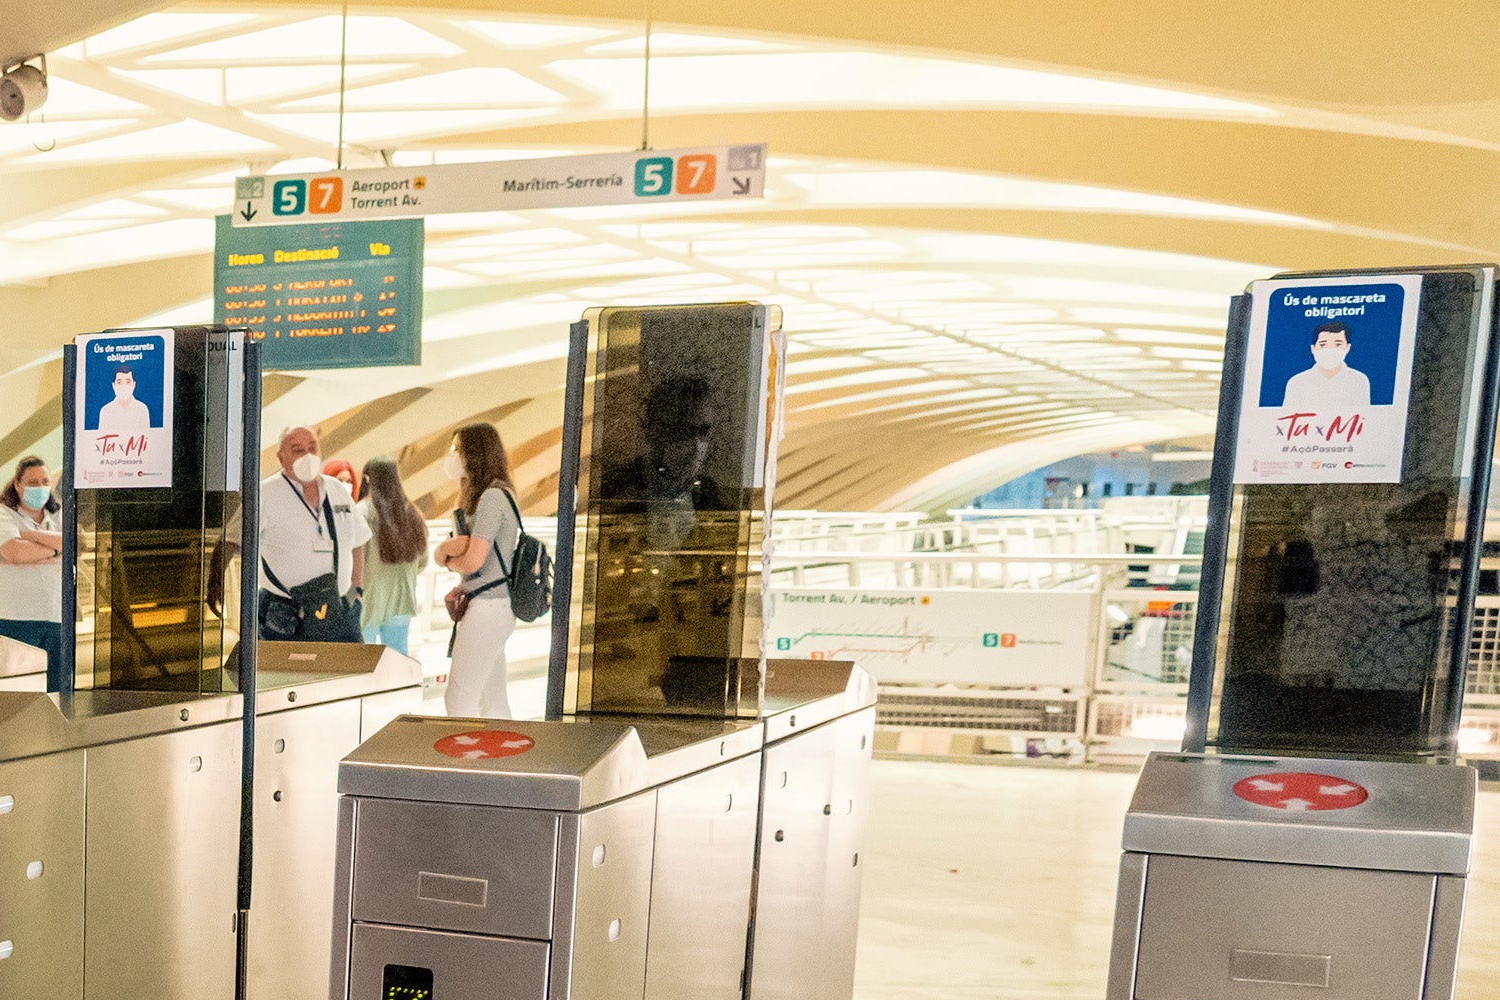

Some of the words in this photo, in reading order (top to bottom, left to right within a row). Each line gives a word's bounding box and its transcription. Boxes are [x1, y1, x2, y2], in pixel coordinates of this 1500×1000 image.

[643, 164, 663, 192] 5
[688, 161, 706, 188] 7
[280, 186, 298, 212] 5
[318, 183, 334, 209] 7
[352, 179, 409, 194] Aeroport
[351, 196, 398, 209] Torrent
[402, 194, 421, 206] Av.
[1283, 293, 1300, 306] Ús
[1302, 295, 1318, 305] de
[1320, 293, 1386, 304] mascareta
[1304, 305, 1365, 319] obligatori
[93, 343, 104, 353] Ús
[116, 343, 154, 351] mascareta
[107, 352, 142, 363] obligatori
[782, 592, 826, 604] Torrent
[830, 593, 847, 604] Av.
[861, 594, 916, 606] Aeroport
